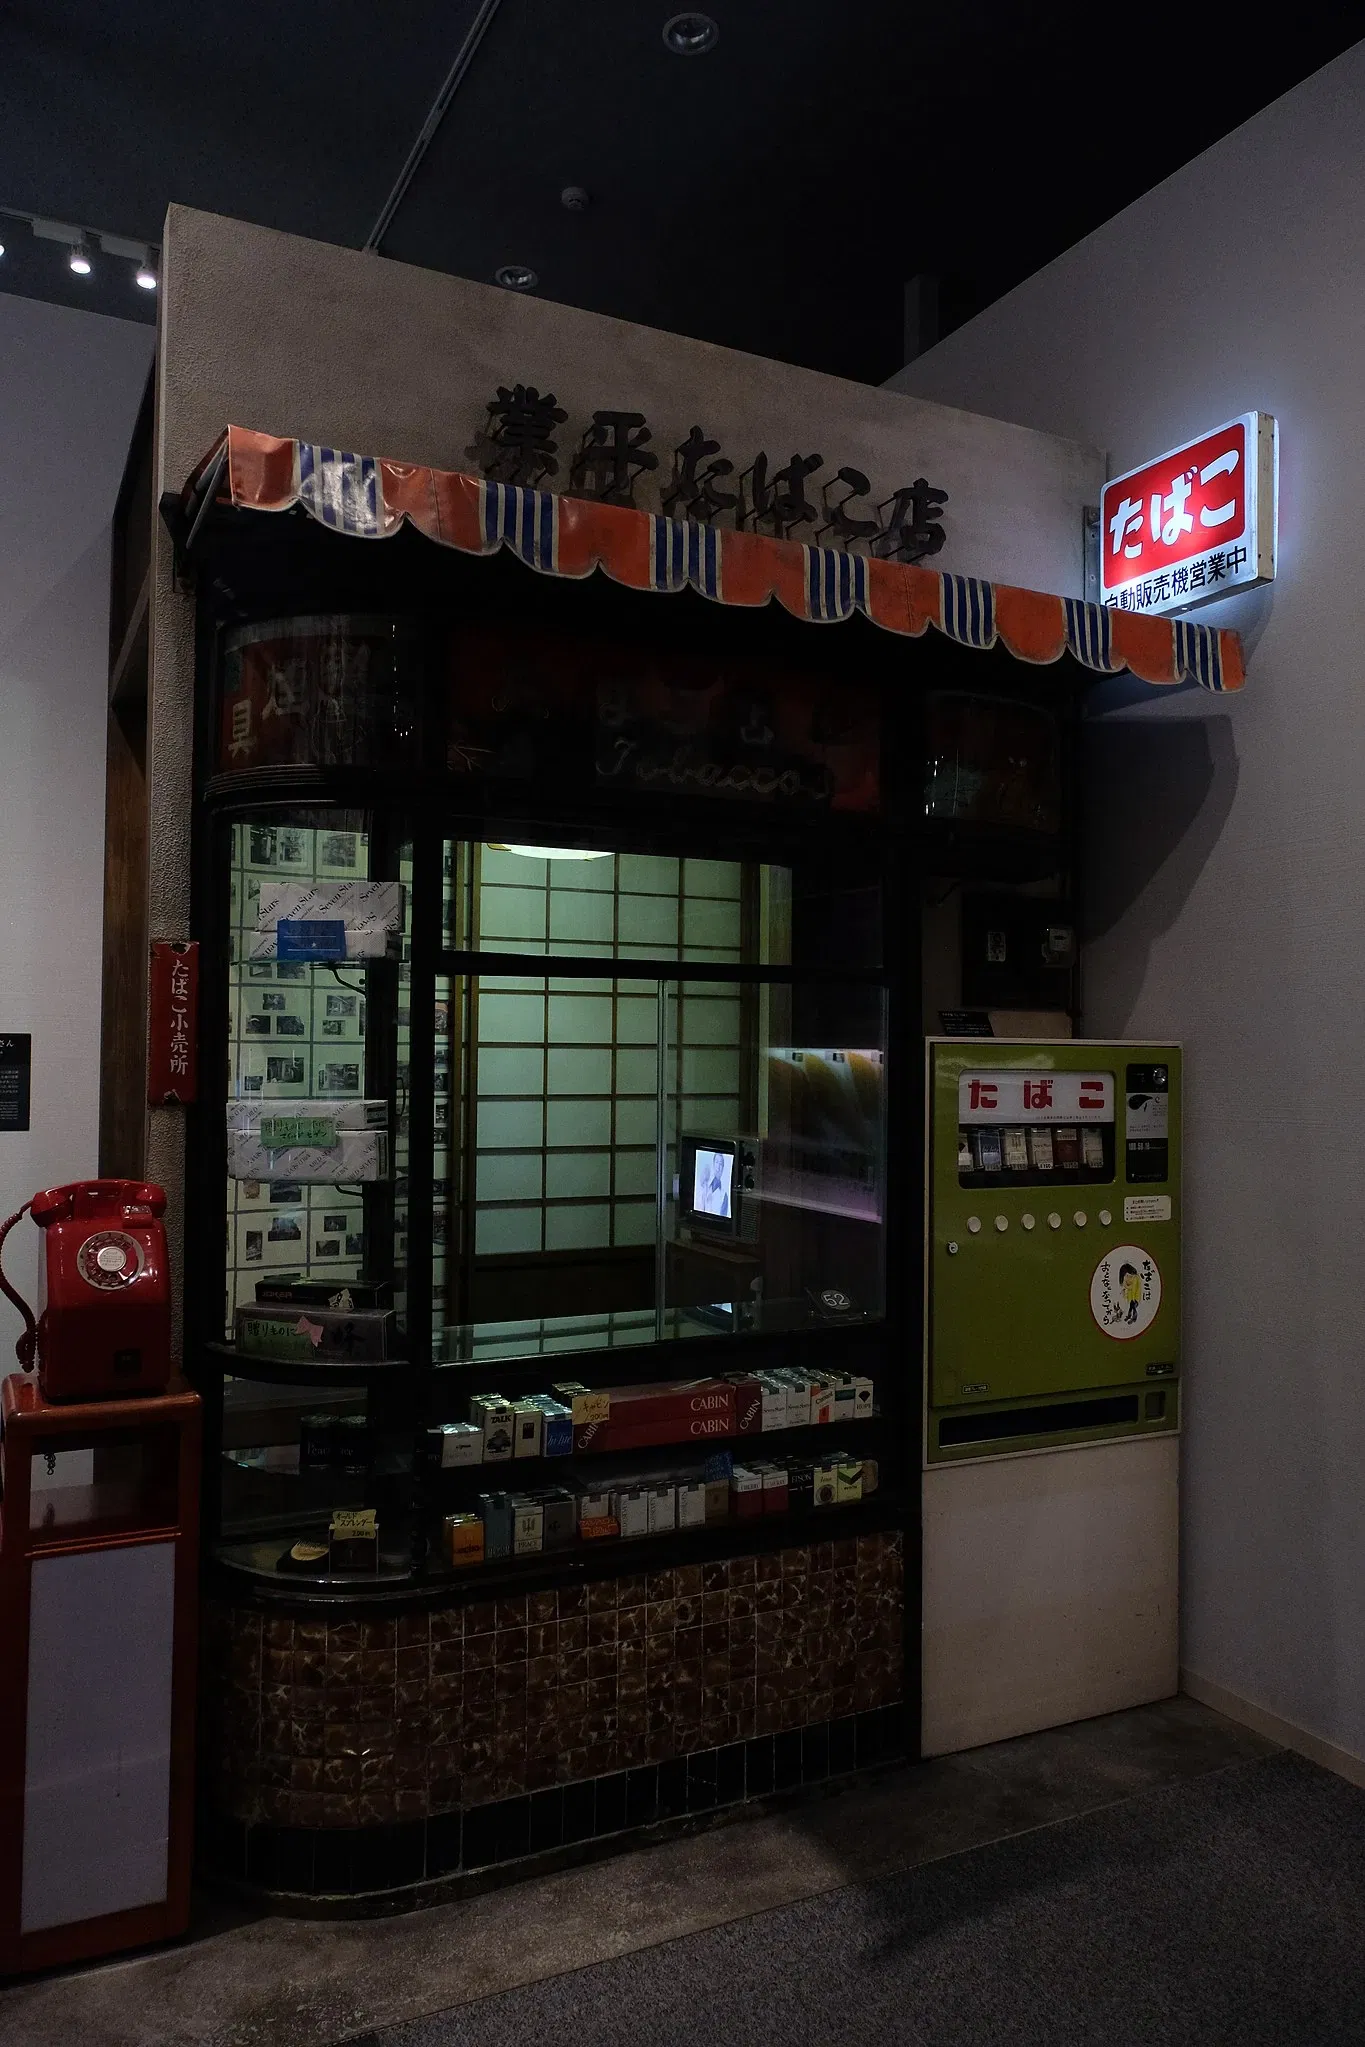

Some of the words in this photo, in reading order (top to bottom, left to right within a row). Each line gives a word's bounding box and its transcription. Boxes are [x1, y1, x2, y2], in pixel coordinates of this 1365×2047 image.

[1109, 448, 1241, 559] たばこ
[169, 958, 190, 1077] たばこ小売所
[967, 1078, 1106, 1110] たばこ
[823, 1292, 849, 1310] 52
[690, 1393, 729, 1412] CABIN
[739, 1399, 762, 1431] CABIN
[690, 1417, 730, 1436] CABIN
